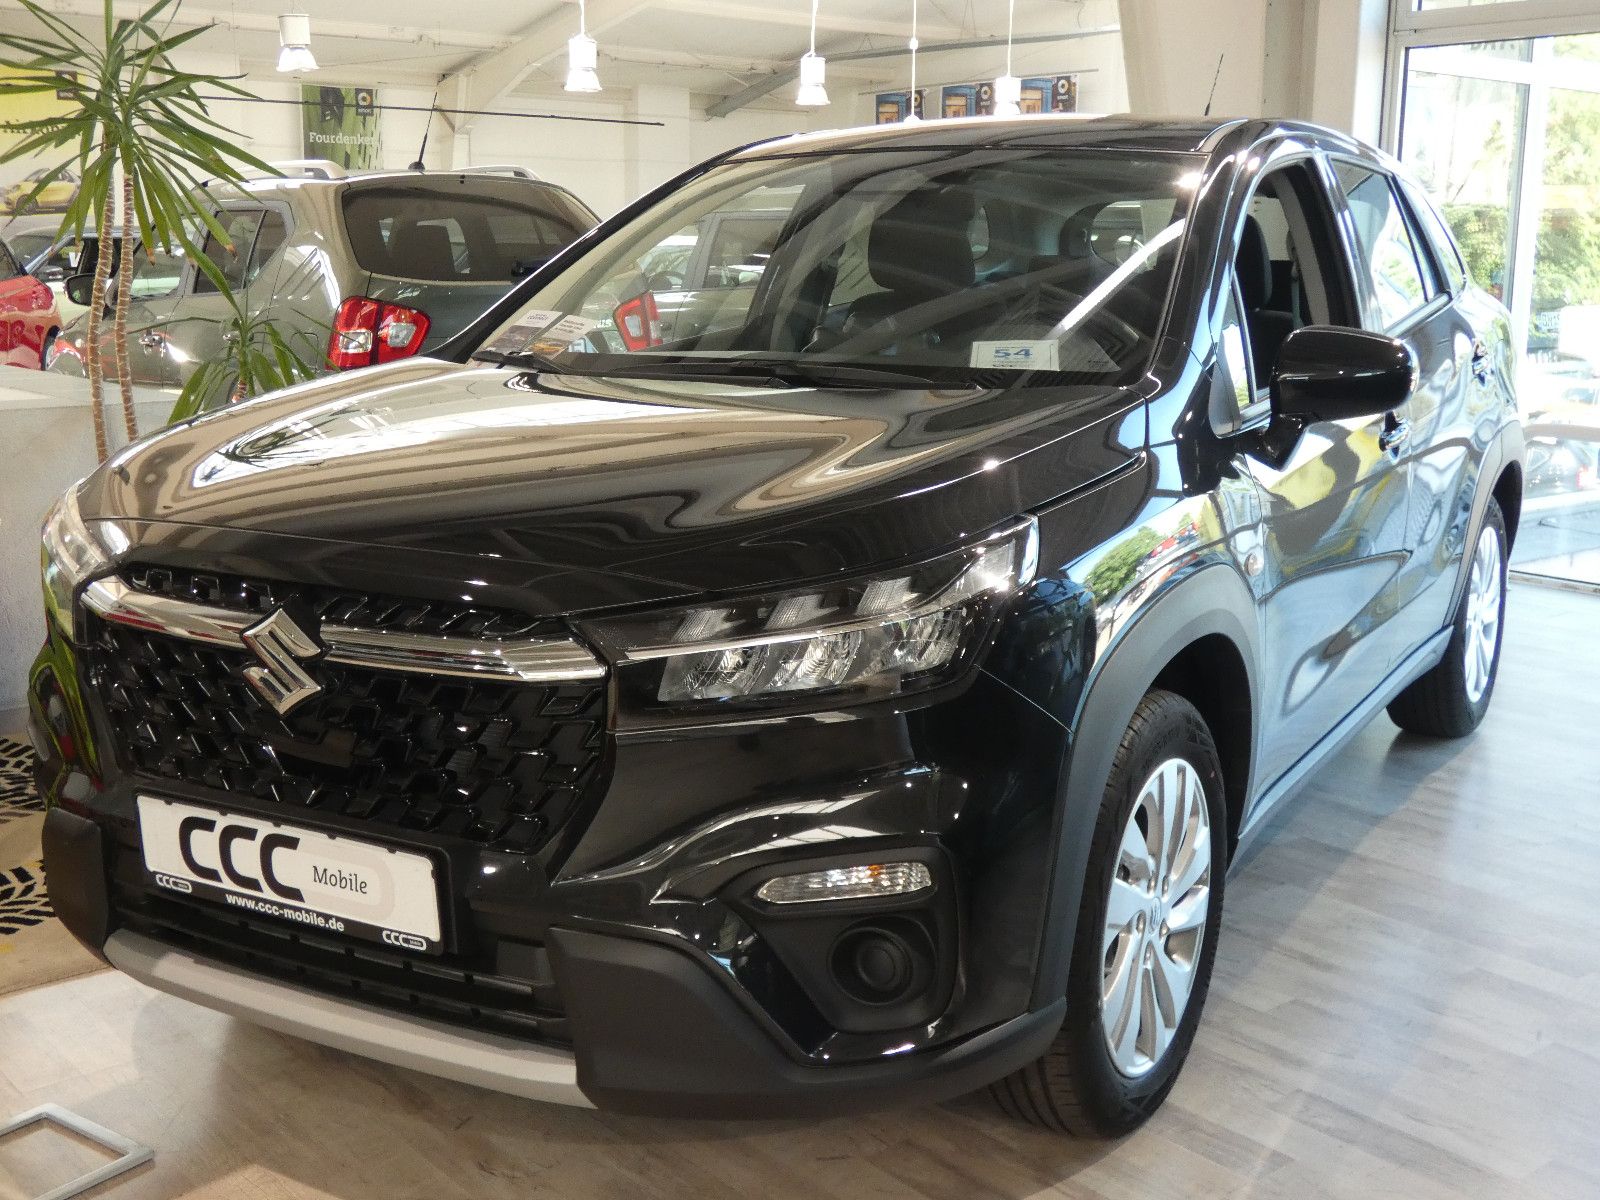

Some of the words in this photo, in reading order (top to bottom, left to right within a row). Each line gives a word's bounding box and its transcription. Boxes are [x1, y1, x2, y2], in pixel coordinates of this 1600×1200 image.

[179, 816, 306, 903] CCC
[312, 865, 368, 894] Mobile
[225, 892, 345, 932] www.ccc-mobile.de
